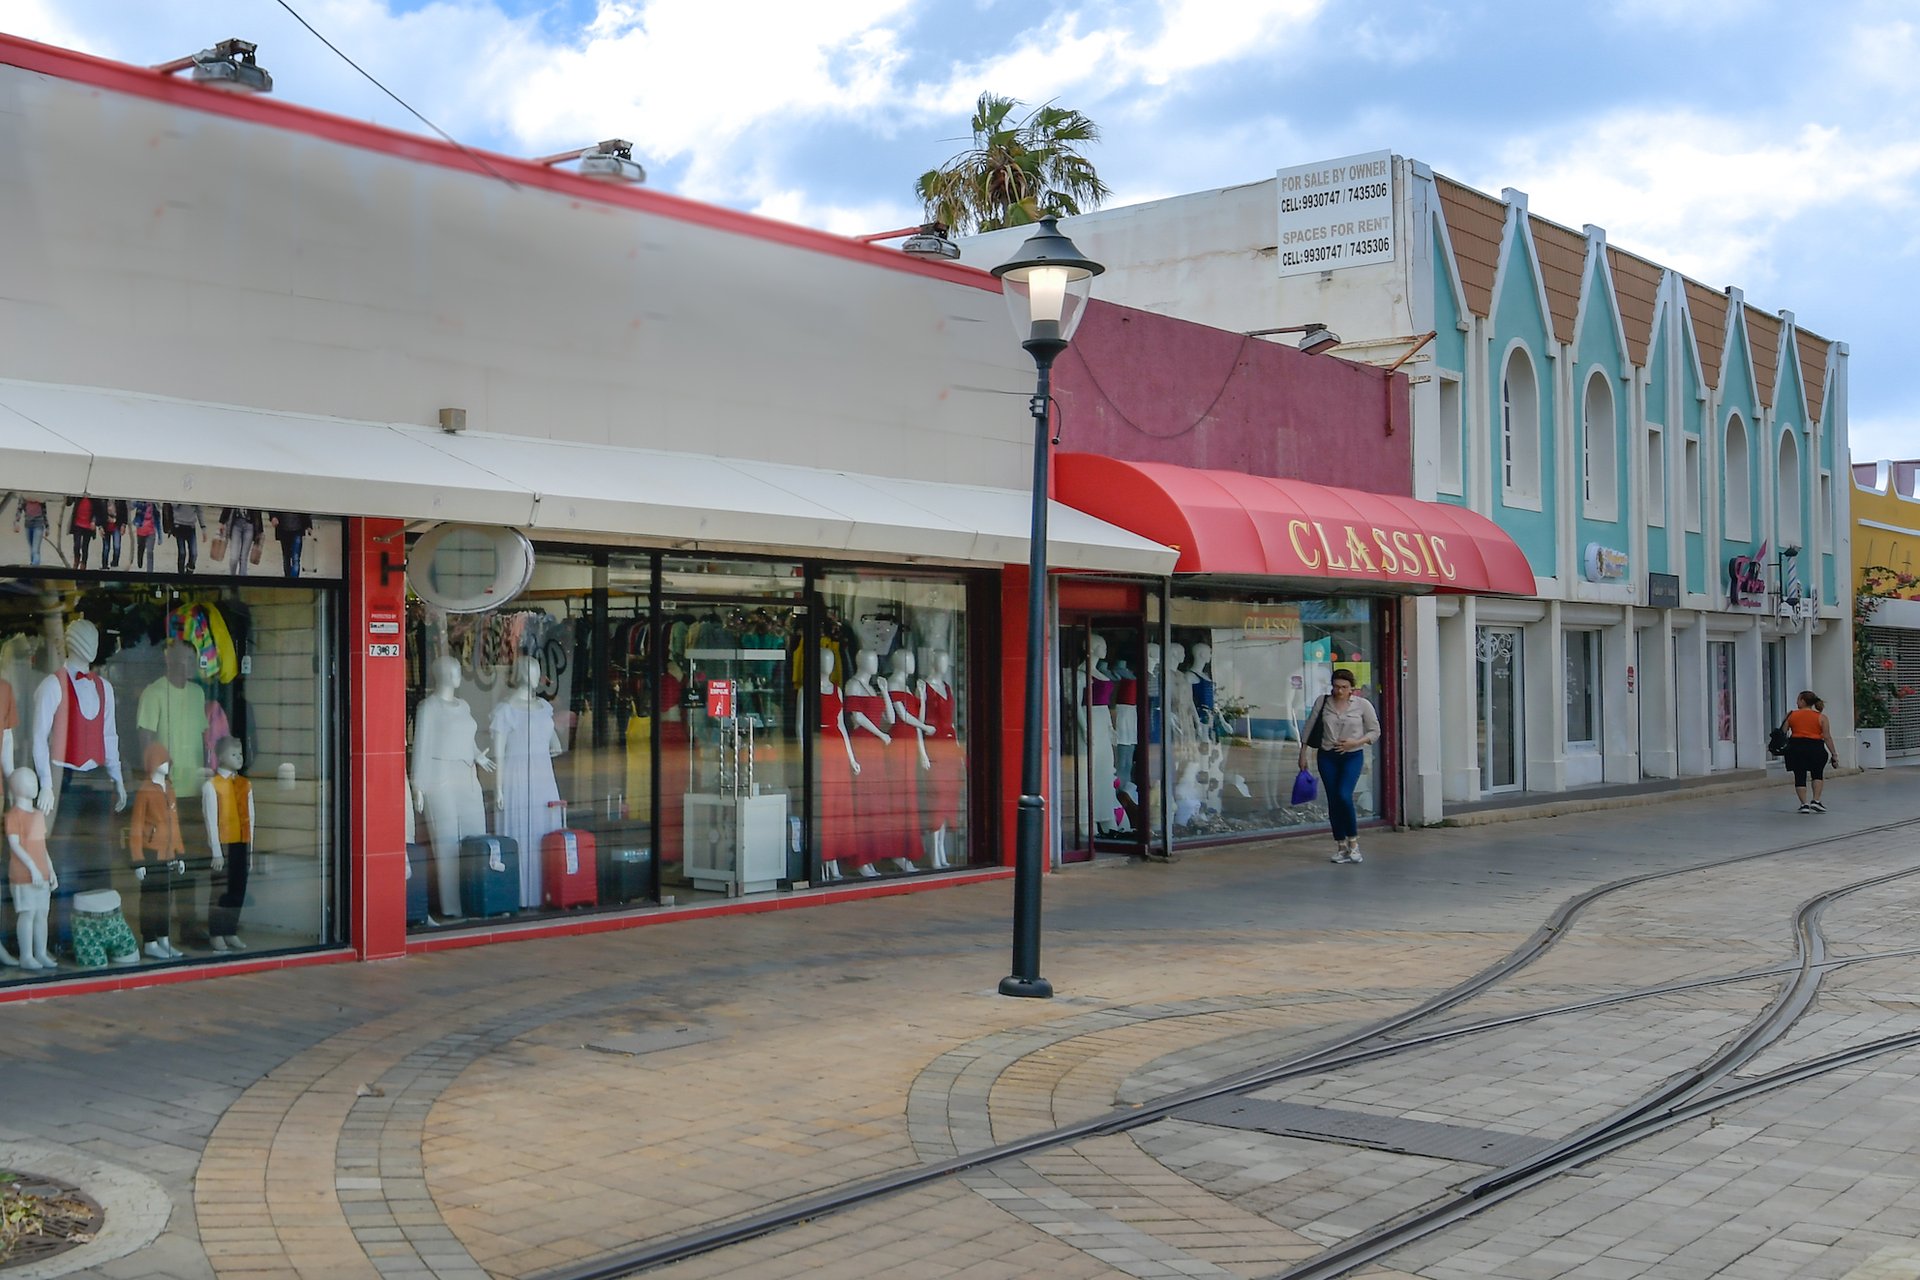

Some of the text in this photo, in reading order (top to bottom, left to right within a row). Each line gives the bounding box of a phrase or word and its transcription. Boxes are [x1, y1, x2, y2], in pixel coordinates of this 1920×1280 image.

[1282, 160, 1387, 192] FOR SALE BY OWNER
[1348, 182, 1387, 203] 7435306
[1283, 216, 1390, 245] SPACES FOR RENT
[1350, 237, 1390, 256] 7435306
[1288, 519, 1457, 581] CLASSIC
[1244, 616, 1300, 636] CLASSIC
